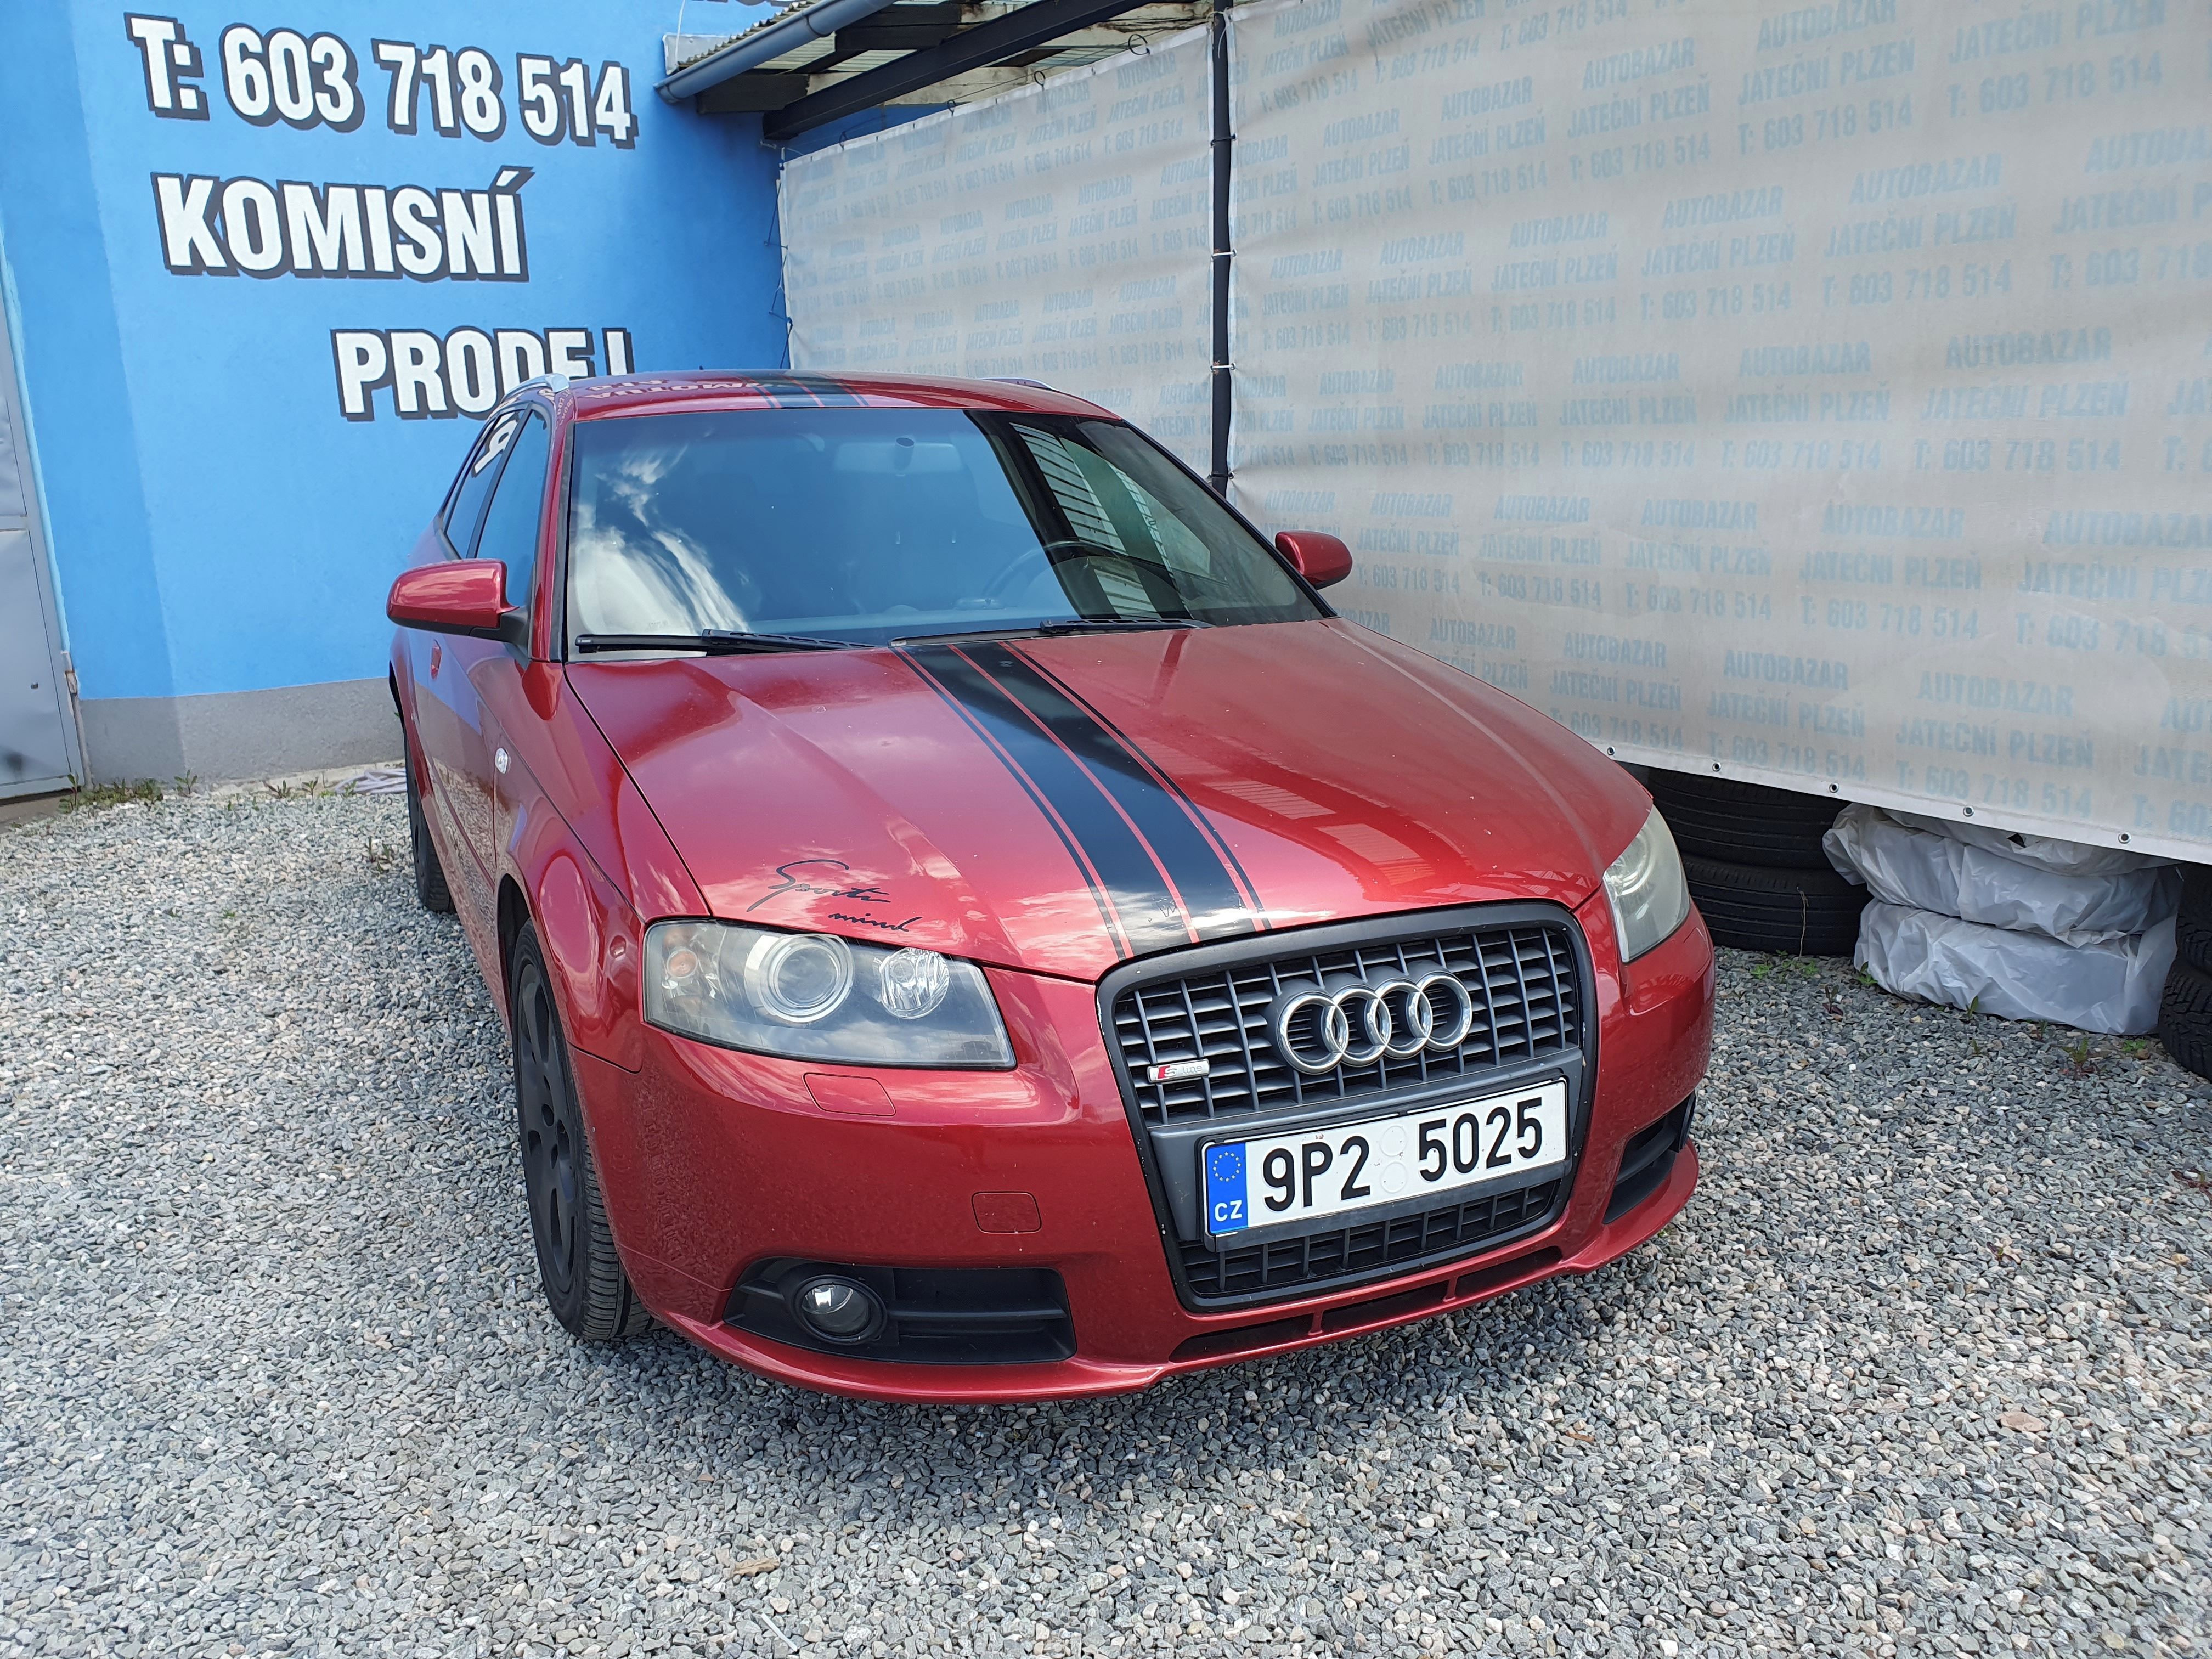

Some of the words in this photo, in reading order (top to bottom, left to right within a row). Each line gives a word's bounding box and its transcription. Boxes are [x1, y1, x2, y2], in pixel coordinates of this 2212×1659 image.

[1758, 0, 1896, 51] AUTOBAZAR
[1583, 37, 1695, 90] AUTOBAZAR
[1839, 30, 1913, 86] PLZEŇ
[125, 13, 208, 119] T:
[221, 24, 363, 132] 603
[373, 40, 505, 141] 718
[518, 54, 637, 148] 514
[1441, 75, 1533, 121] AUTOBAZAR
[1649, 74, 1709, 122] PLZEŇ
[1980, 73, 2030, 114] 603
[2044, 61, 2095, 103] 718
[2108, 48, 2164, 92] 514
[1323, 108, 1400, 148] AUTOBAZAR
[1496, 109, 1545, 152] PLZEŇ
[1765, 114, 1805, 149] 603
[1816, 105, 1857, 142] 718
[1867, 95, 1911, 133] 514
[1369, 138, 1409, 177] PLZEŇ
[1592, 148, 1623, 179] 603
[1633, 140, 1666, 172] 718
[1674, 132, 1709, 165] 514
[1448, 174, 1475, 202] 603
[1482, 167, 1510, 196] 718
[1517, 161, 1546, 191] 514
[1851, 153, 2002, 204] AUTOBAZAR
[1328, 196, 1351, 222] 603
[1357, 191, 1380, 217] 718
[1386, 185, 1410, 212] 514
[1662, 185, 1784, 229] AUTOBAZAR
[1933, 195, 2015, 246] PLZEŇ
[152, 167, 532, 281] KOMISNÍ
[1509, 210, 1609, 250] AUTOBAZAR
[1380, 231, 1464, 266] AUTOBAZAR
[1564, 244, 1617, 284] PLZEŇ
[1729, 223, 1794, 268] PLZEŇ
[1427, 261, 1471, 297] PLZEŇ
[1852, 273, 1895, 306] 603
[1906, 267, 1951, 302] 718
[1962, 262, 2010, 297] 514
[1510, 304, 1539, 331] 603
[1547, 301, 1576, 328] 718
[1584, 297, 1615, 325] 514
[1663, 290, 1698, 320] 603
[1707, 286, 1743, 317] 718
[1752, 282, 1790, 313] 514
[1383, 316, 1407, 341] 603
[1414, 313, 1438, 338] 718
[1445, 310, 1471, 336] 514
[1739, 341, 1871, 376] AUTOBAZAR
[1946, 326, 2112, 367] AUTOBAZAR
[1434, 362, 1523, 390] AUTOBAZAR
[1572, 352, 1680, 383] AUTOBAZAR
[1488, 394, 1535, 427] PLZEŇ
[1638, 388, 1695, 425] PLZEŇ
[1819, 382, 1889, 422] PLZEŇ
[2039, 372, 2129, 417] PLZEŇ
[1444, 443, 1470, 466] 603
[1477, 443, 1504, 467] 718
[1511, 443, 1539, 467] 514
[1582, 443, 1613, 468] 603
[1622, 442, 1654, 468] 718
[1662, 442, 1696, 469] 514
[1745, 441, 1782, 469] 603
[1793, 441, 1831, 469] 718
[1841, 441, 1883, 470] 514
[1946, 439, 1993, 471] 603
[2006, 439, 2054, 471] 718
[2067, 439, 2119, 472] 514
[1494, 495, 1590, 522] AUTOBAZAR
[1642, 499, 1757, 528] AUTOBAZAR
[1822, 504, 1965, 538] AUTOBAZAR
[1550, 532, 1600, 565] PLZEŇ
[1709, 539, 1771, 576] PLZEŇ
[1903, 550, 1980, 590] PLZEŇ
[1499, 574, 1527, 600] 603
[1534, 577, 1562, 603] 718
[1570, 580, 1600, 607] 514
[1649, 586, 1681, 614] 603
[1691, 589, 1725, 618] 718
[1734, 592, 1770, 622] 514
[1828, 600, 1869, 631] 603
[1880, 604, 1922, 636] 718
[1933, 608, 1978, 642] 514
[1723, 648, 1848, 689] AUTOBAZAR
[1918, 670, 2074, 717] AUTOBAZAR
[1798, 701, 1865, 739] PLZEŇ
[1733, 737, 1769, 768] 603
[1779, 743, 1816, 776] 718
[1825, 751, 1865, 785] 514
[2008, 729, 2092, 771] PLZEŇ
[1926, 766, 1971, 801] 603
[1984, 774, 2029, 810] 718
[2041, 784, 2091, 822] 514
[1181, 1065, 1203, 1075] line
[1262, 1135, 1371, 1212] 9P2
[1419, 1097, 1543, 1182] 5025
[1214, 1198, 1243, 1222] CZ
